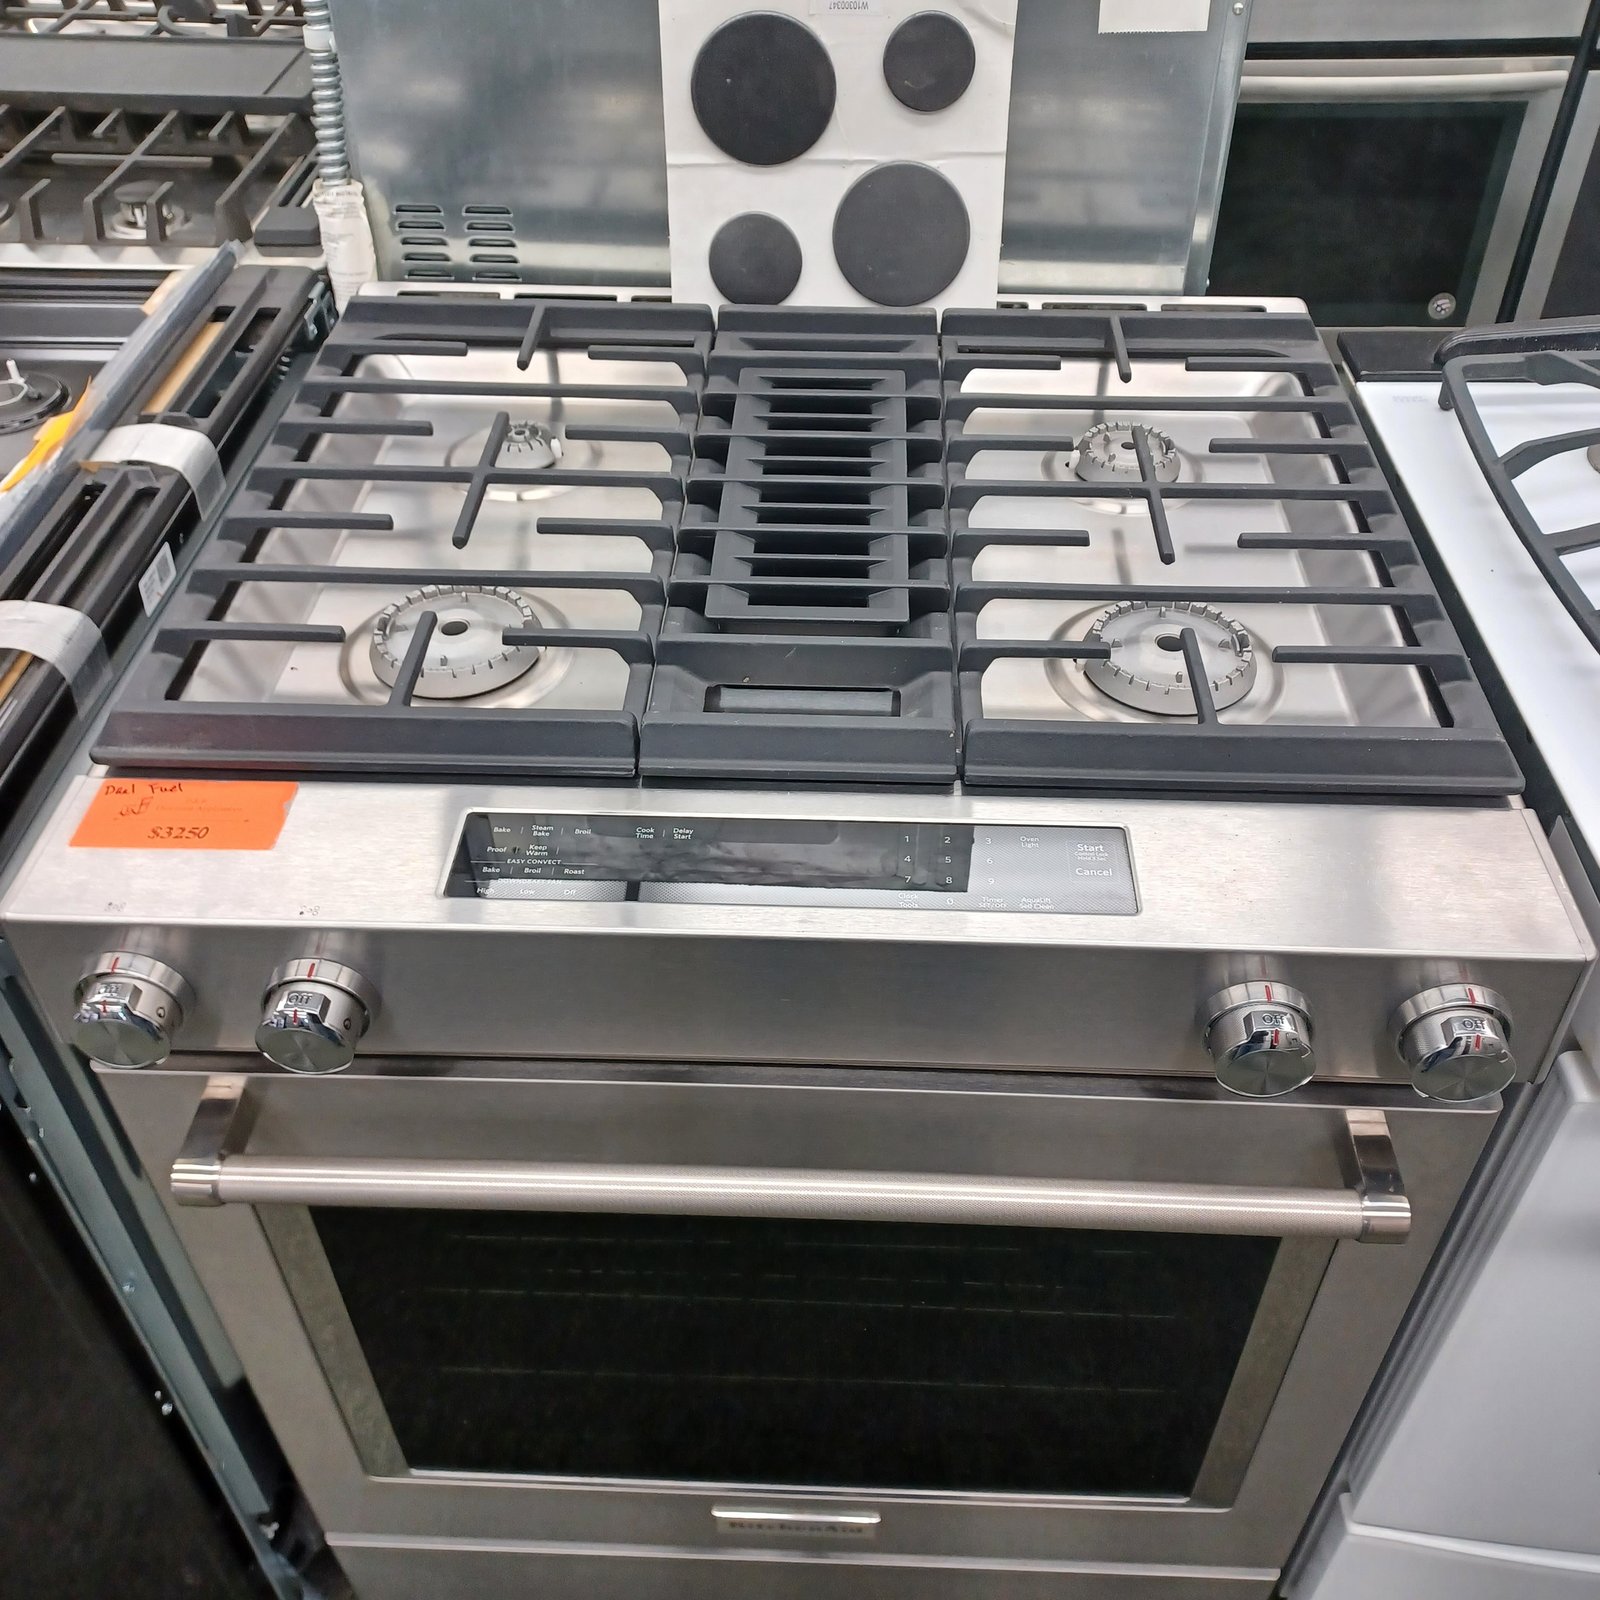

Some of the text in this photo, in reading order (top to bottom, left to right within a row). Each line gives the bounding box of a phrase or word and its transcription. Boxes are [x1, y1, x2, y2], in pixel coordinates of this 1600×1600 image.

[148, 782, 184, 795] Fuel
[673, 827, 694, 835] Delay
[944, 836, 951, 844] 2
[985, 837, 992, 845] 3
[487, 846, 507, 854] Proof
[1077, 843, 1104, 852] Start
[945, 856, 952, 864] 5
[986, 857, 993, 865] 6
[1075, 867, 1113, 876] Cancel
[904, 876, 911, 884] 7
[945, 876, 953, 884] 8
[988, 877, 995, 885] 9
[477, 887, 495, 895] High
[898, 892, 918, 900] Clock
[946, 897, 954, 906] 0
[287, 992, 313, 1006] Off
[1261, 1012, 1286, 1026] Off
[1462, 1018, 1487, 1031] Off
